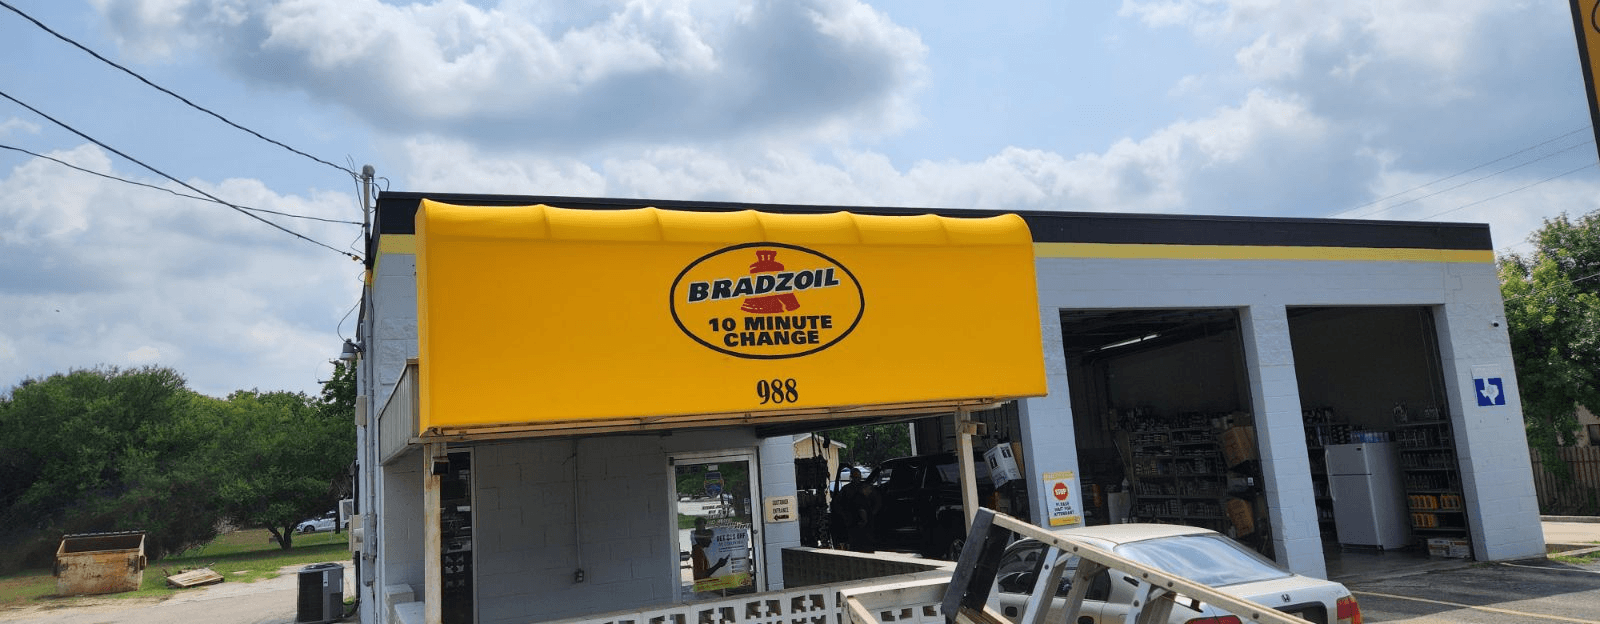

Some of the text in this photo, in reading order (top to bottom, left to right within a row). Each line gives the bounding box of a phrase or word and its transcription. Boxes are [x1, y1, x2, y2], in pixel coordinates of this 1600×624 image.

[687, 267, 840, 303] BRADZOIL
[708, 315, 833, 332] 10 MINUTE
[723, 330, 820, 347] CHANGE
[756, 378, 799, 405] 988
